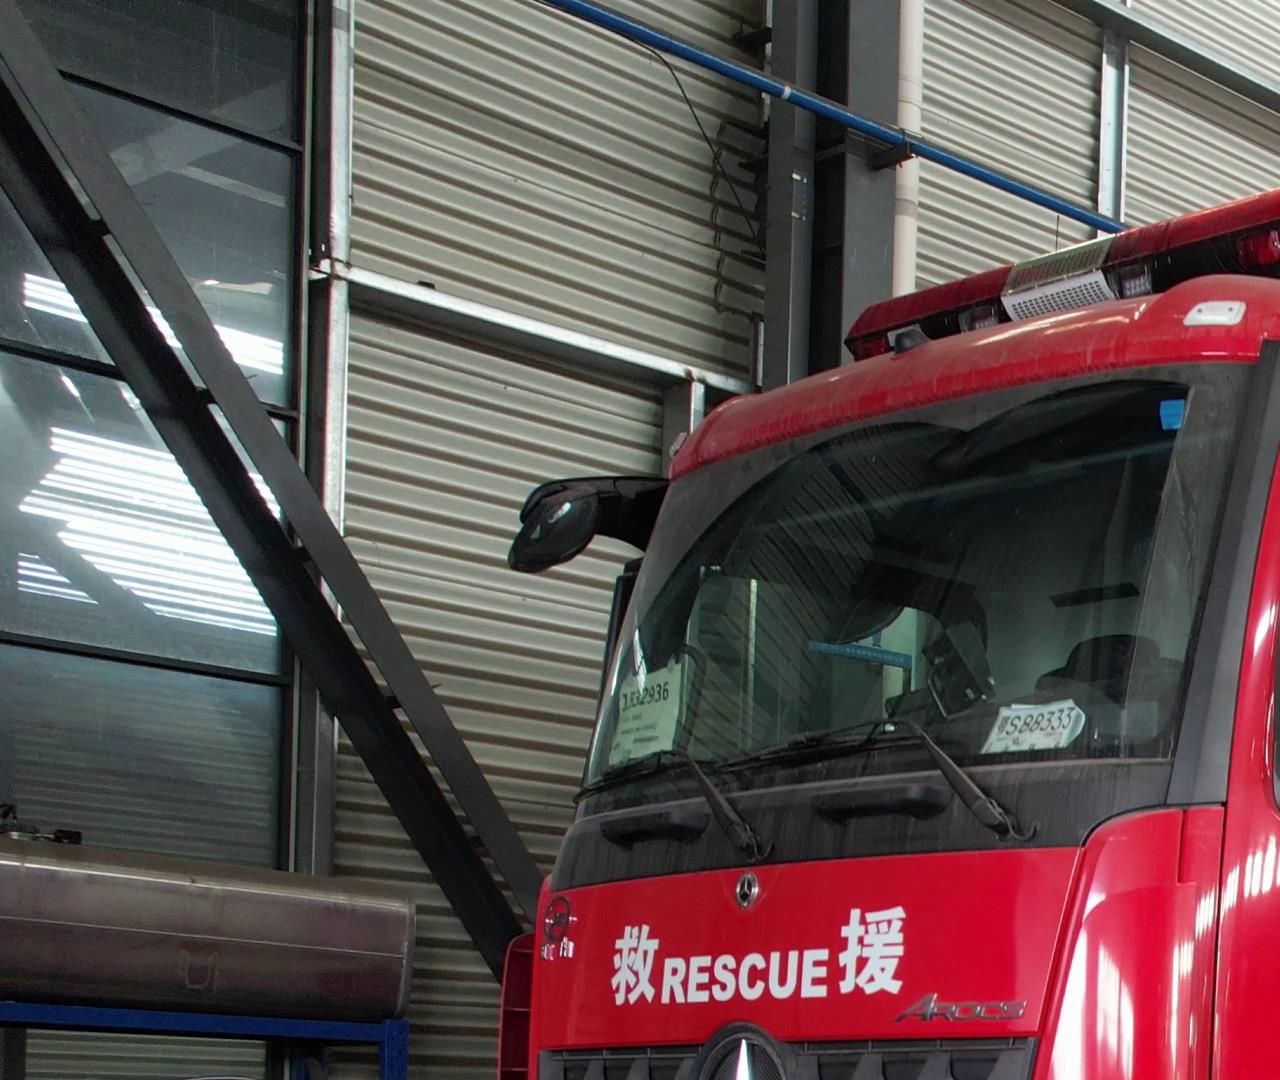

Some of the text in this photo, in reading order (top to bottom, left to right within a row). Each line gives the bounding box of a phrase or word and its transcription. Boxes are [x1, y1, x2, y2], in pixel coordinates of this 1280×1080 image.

[611, 906, 907, 1006] 救 RESCUE 援
